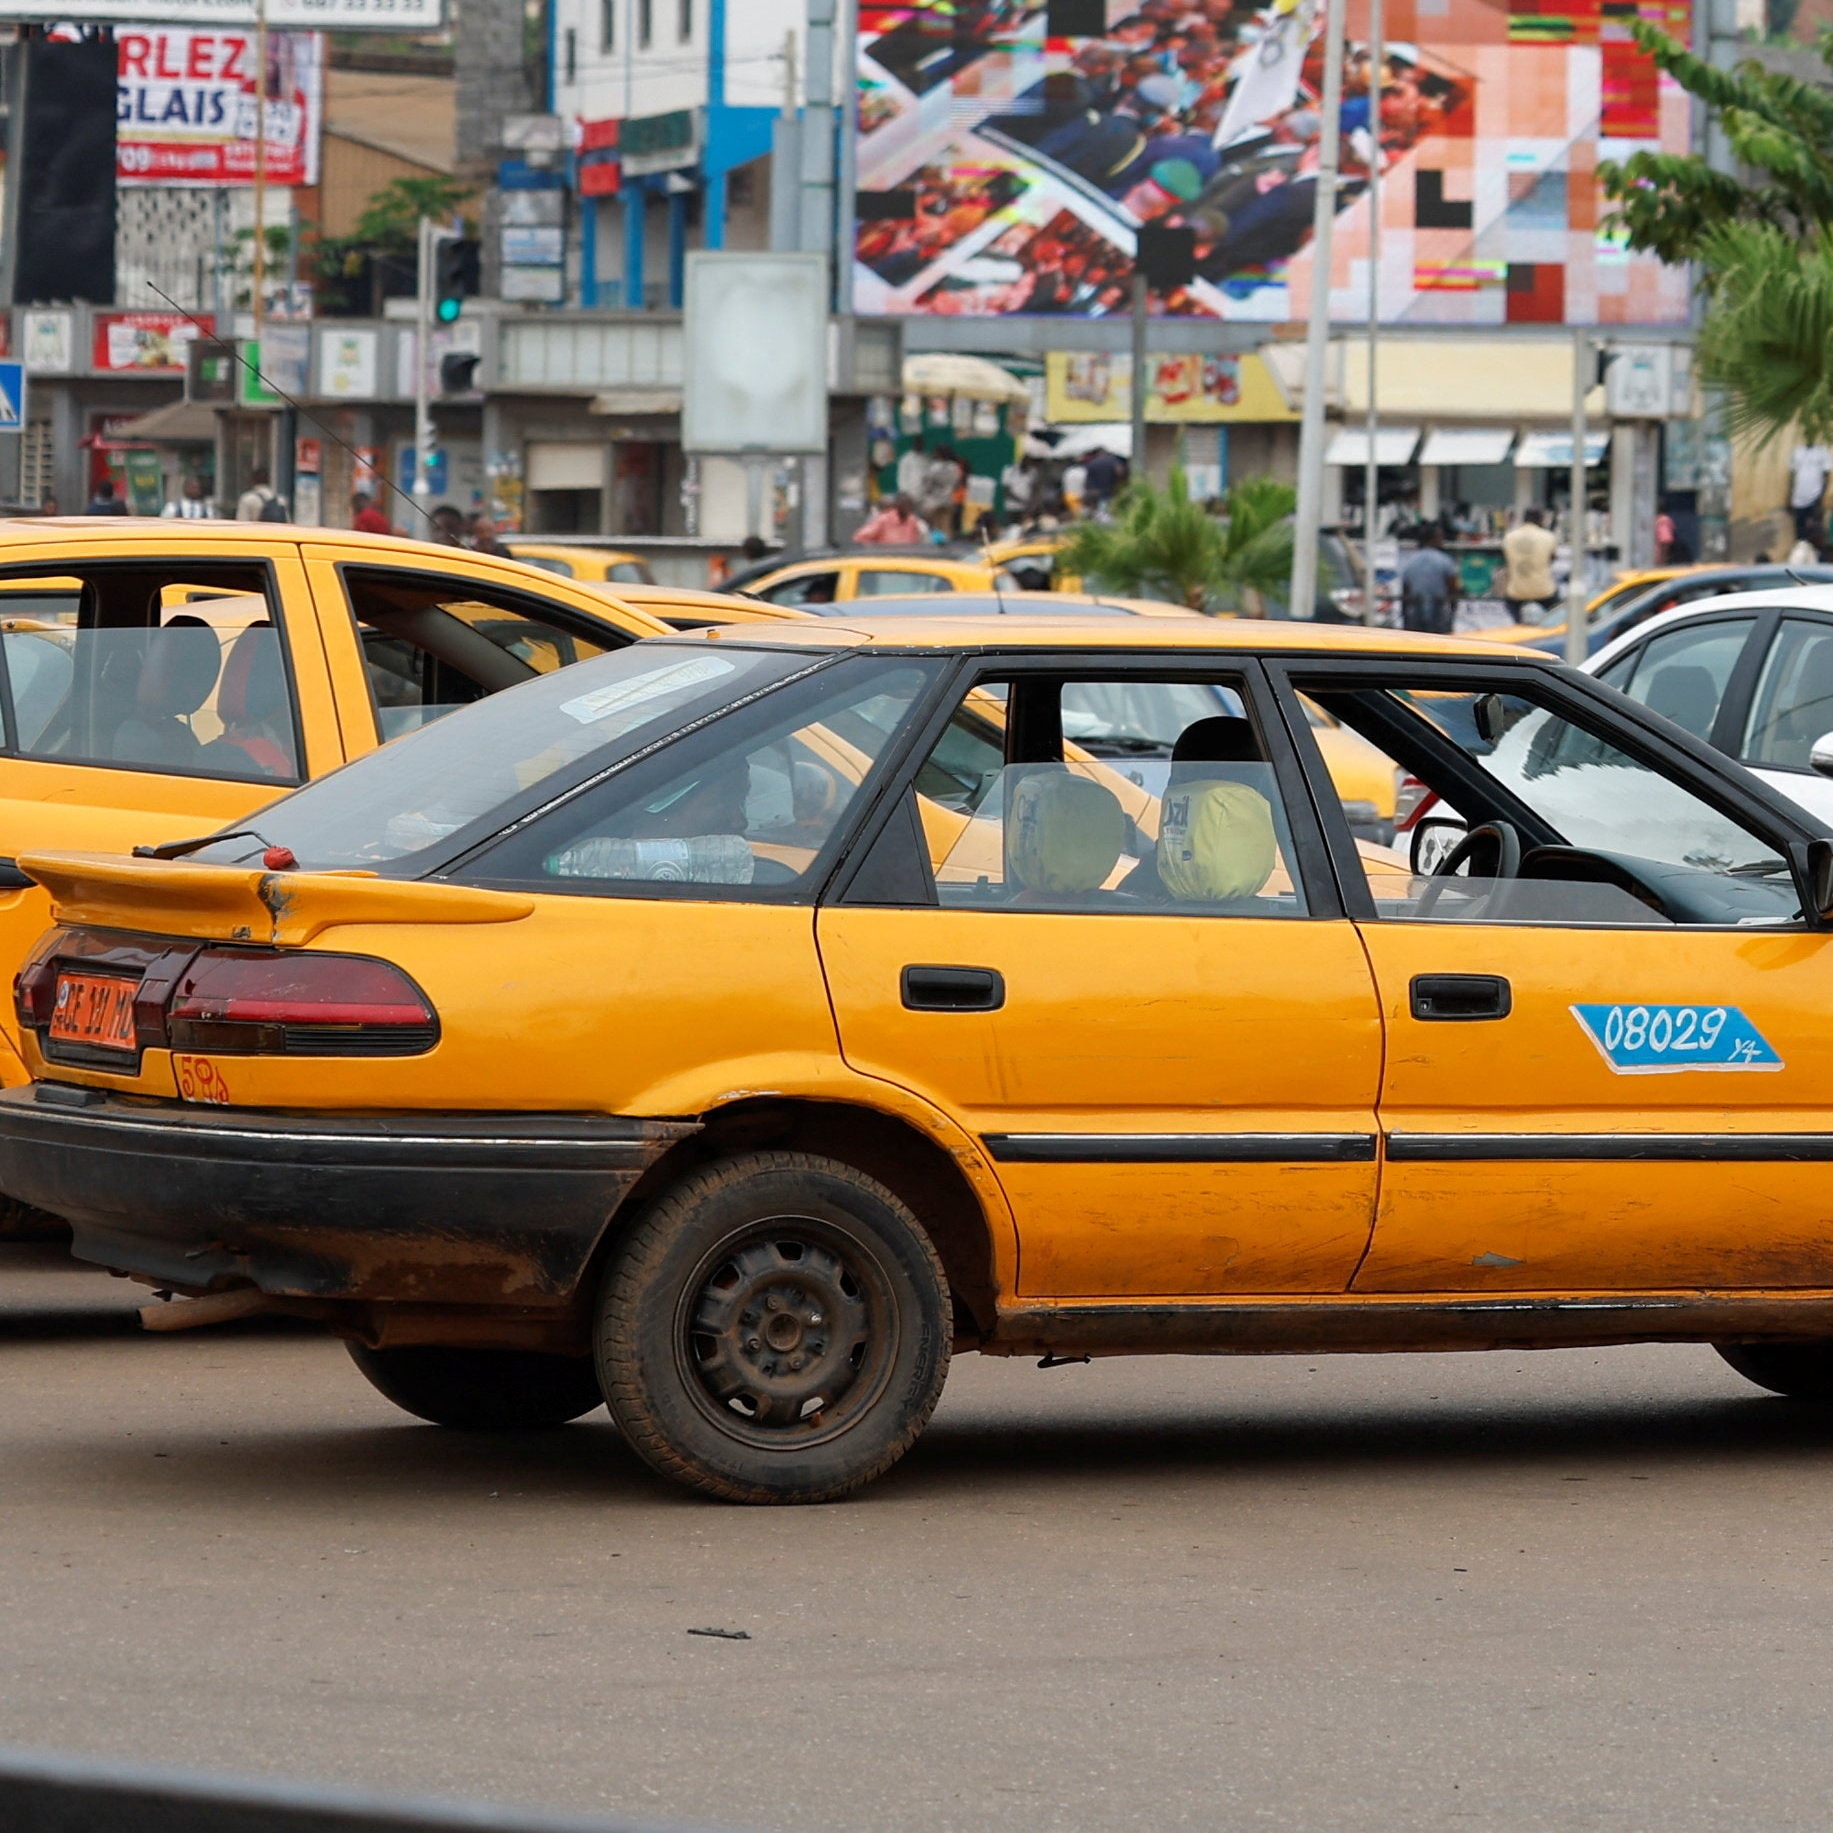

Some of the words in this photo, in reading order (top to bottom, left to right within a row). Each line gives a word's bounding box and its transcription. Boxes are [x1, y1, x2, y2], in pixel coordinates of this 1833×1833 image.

[118, 34, 247, 79] RLEZ
[116, 85, 225, 124] GLAIS
[1603, 1005, 1728, 1054] 08029
